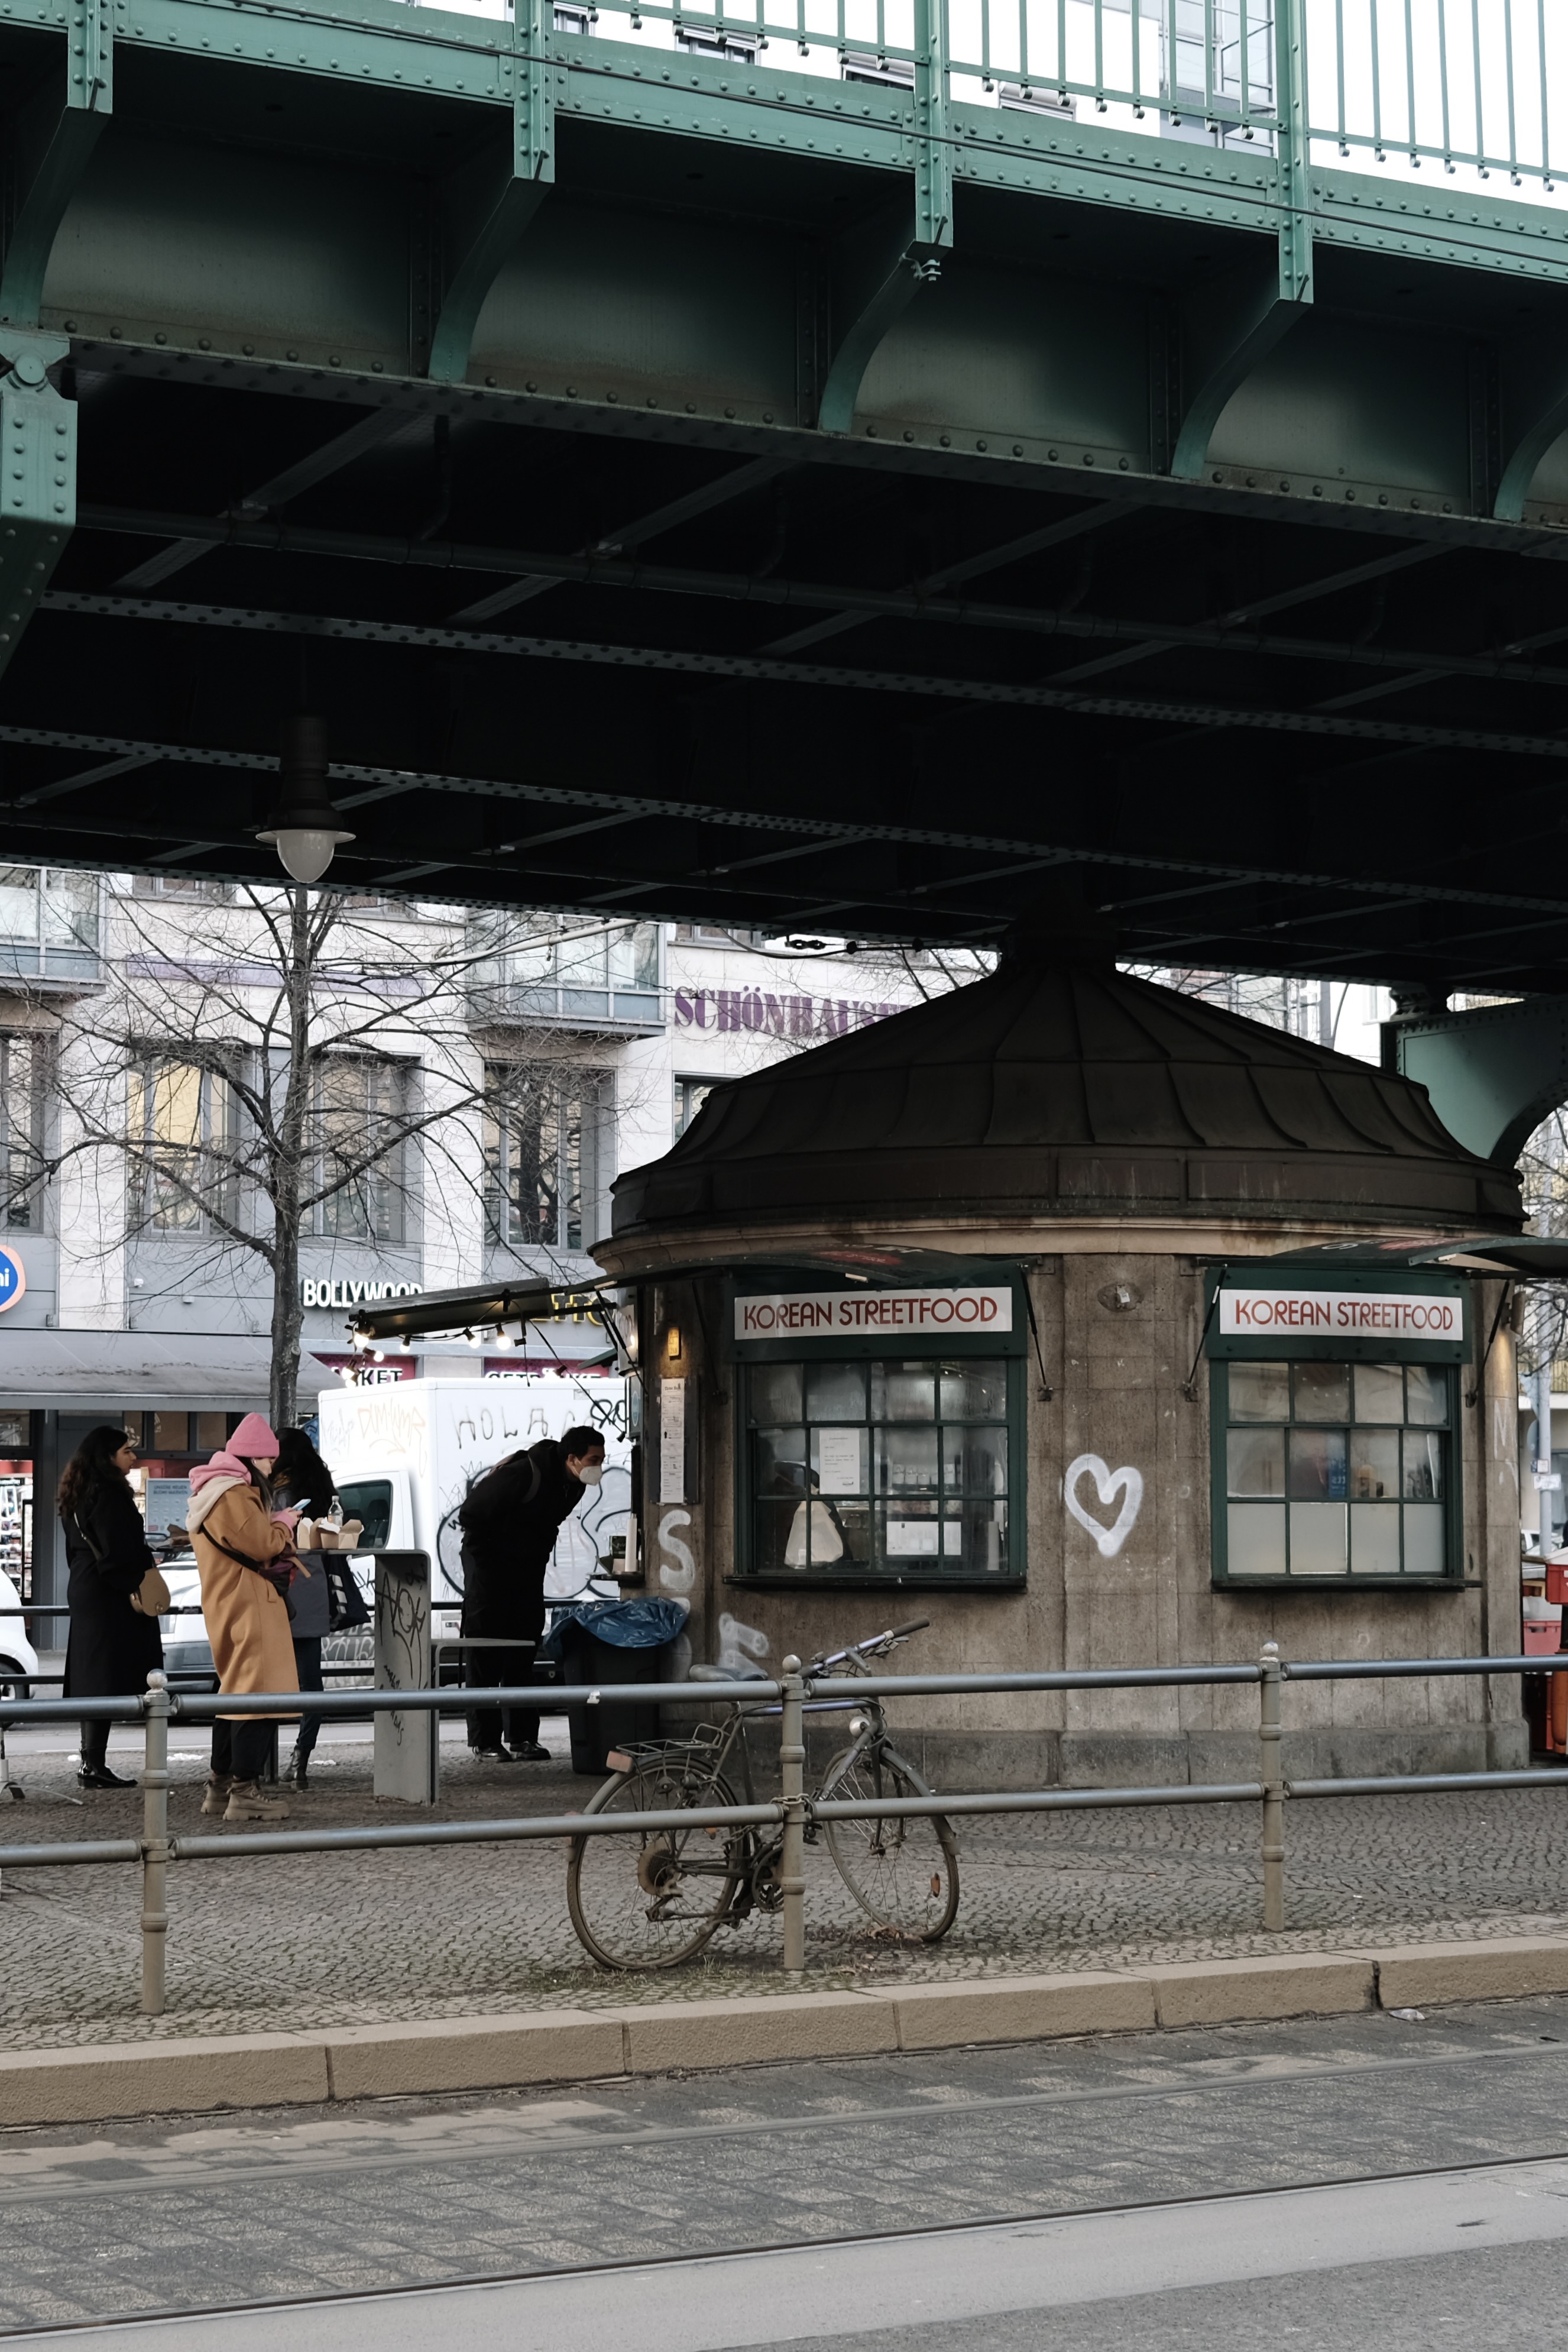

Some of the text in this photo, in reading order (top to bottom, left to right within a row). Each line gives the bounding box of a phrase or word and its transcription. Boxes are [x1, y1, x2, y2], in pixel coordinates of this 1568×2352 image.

[675, 985, 911, 1038] SCHÖNHAUS
[744, 1296, 997, 1330] KOREAN STREETFOOD
[1236, 1299, 1453, 1330] KOREAN STREETFOOD
